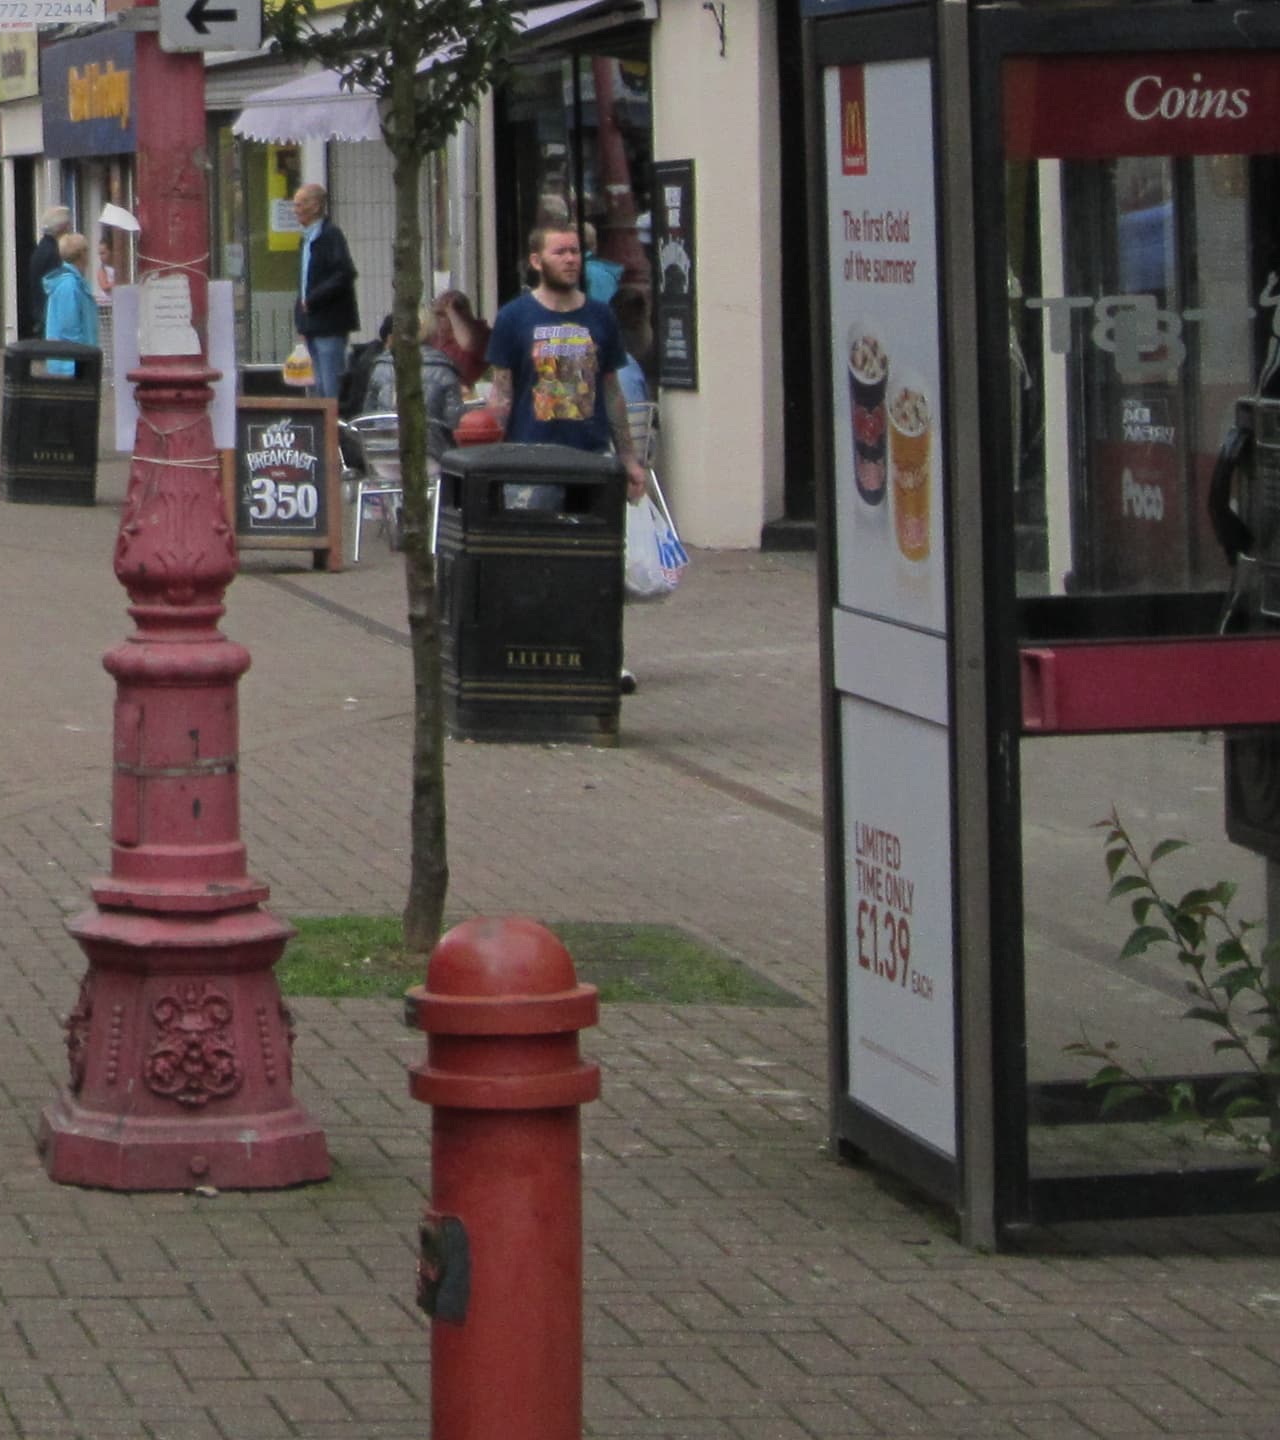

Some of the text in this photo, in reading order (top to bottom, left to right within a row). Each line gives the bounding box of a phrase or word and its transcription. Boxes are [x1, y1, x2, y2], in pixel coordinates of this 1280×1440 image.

[34, 2, 93, 17] 722444
[1125, 72, 1251, 121] Coins
[843, 210, 911, 243] The first Gold
[844, 250, 917, 284] of the summer
[262, 432, 296, 449] DAY
[247, 448, 319, 472] BREAKFAST
[507, 651, 581, 667] LITTER
[855, 820, 902, 871] LIMITED
[855, 859, 915, 916] TIME ONLY
[856, 898, 911, 988] £1.39
[911, 970, 934, 1000] EACH
